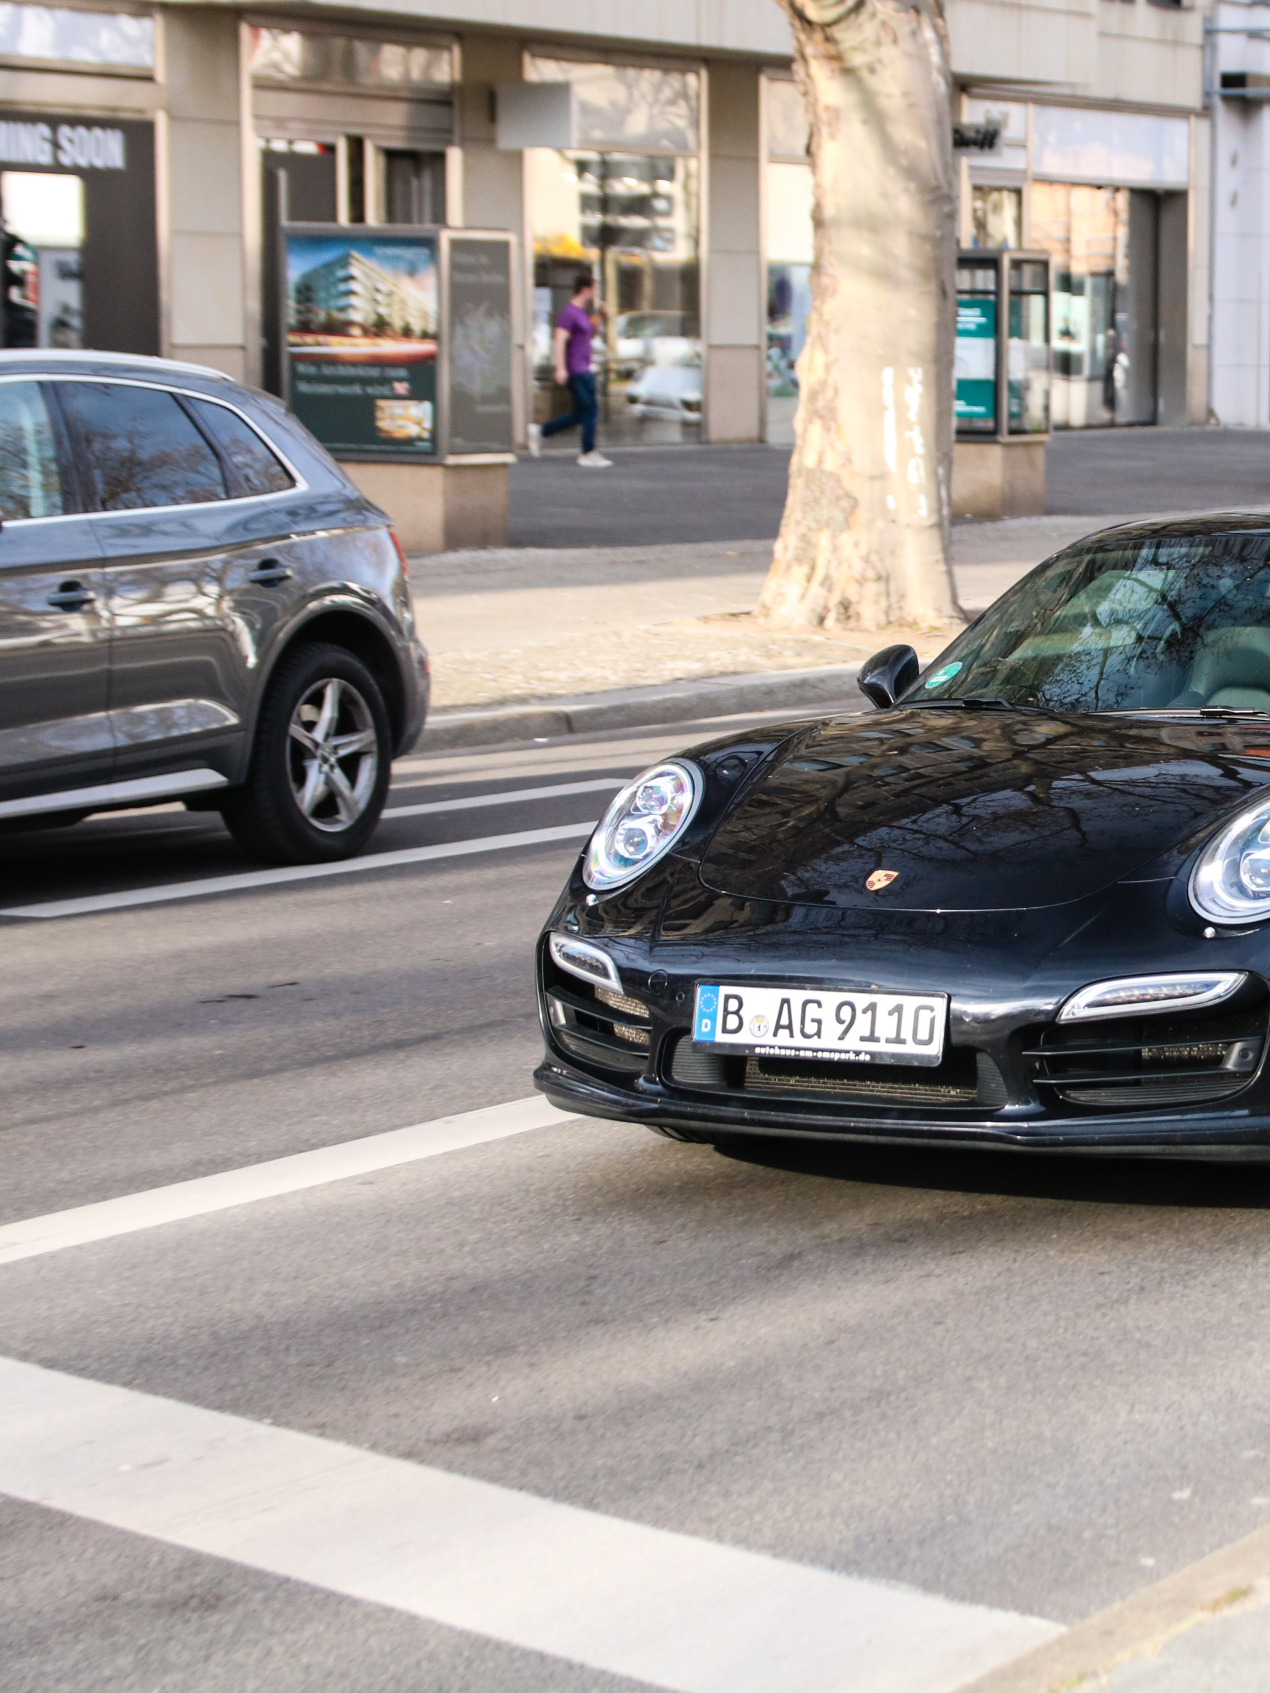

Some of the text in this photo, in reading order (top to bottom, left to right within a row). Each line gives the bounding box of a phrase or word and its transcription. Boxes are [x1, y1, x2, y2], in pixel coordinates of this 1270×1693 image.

[57, 123, 125, 170] SOON
[721, 993, 744, 1035] B
[772, 997, 823, 1040] AG
[835, 1000, 936, 1046] 9110
